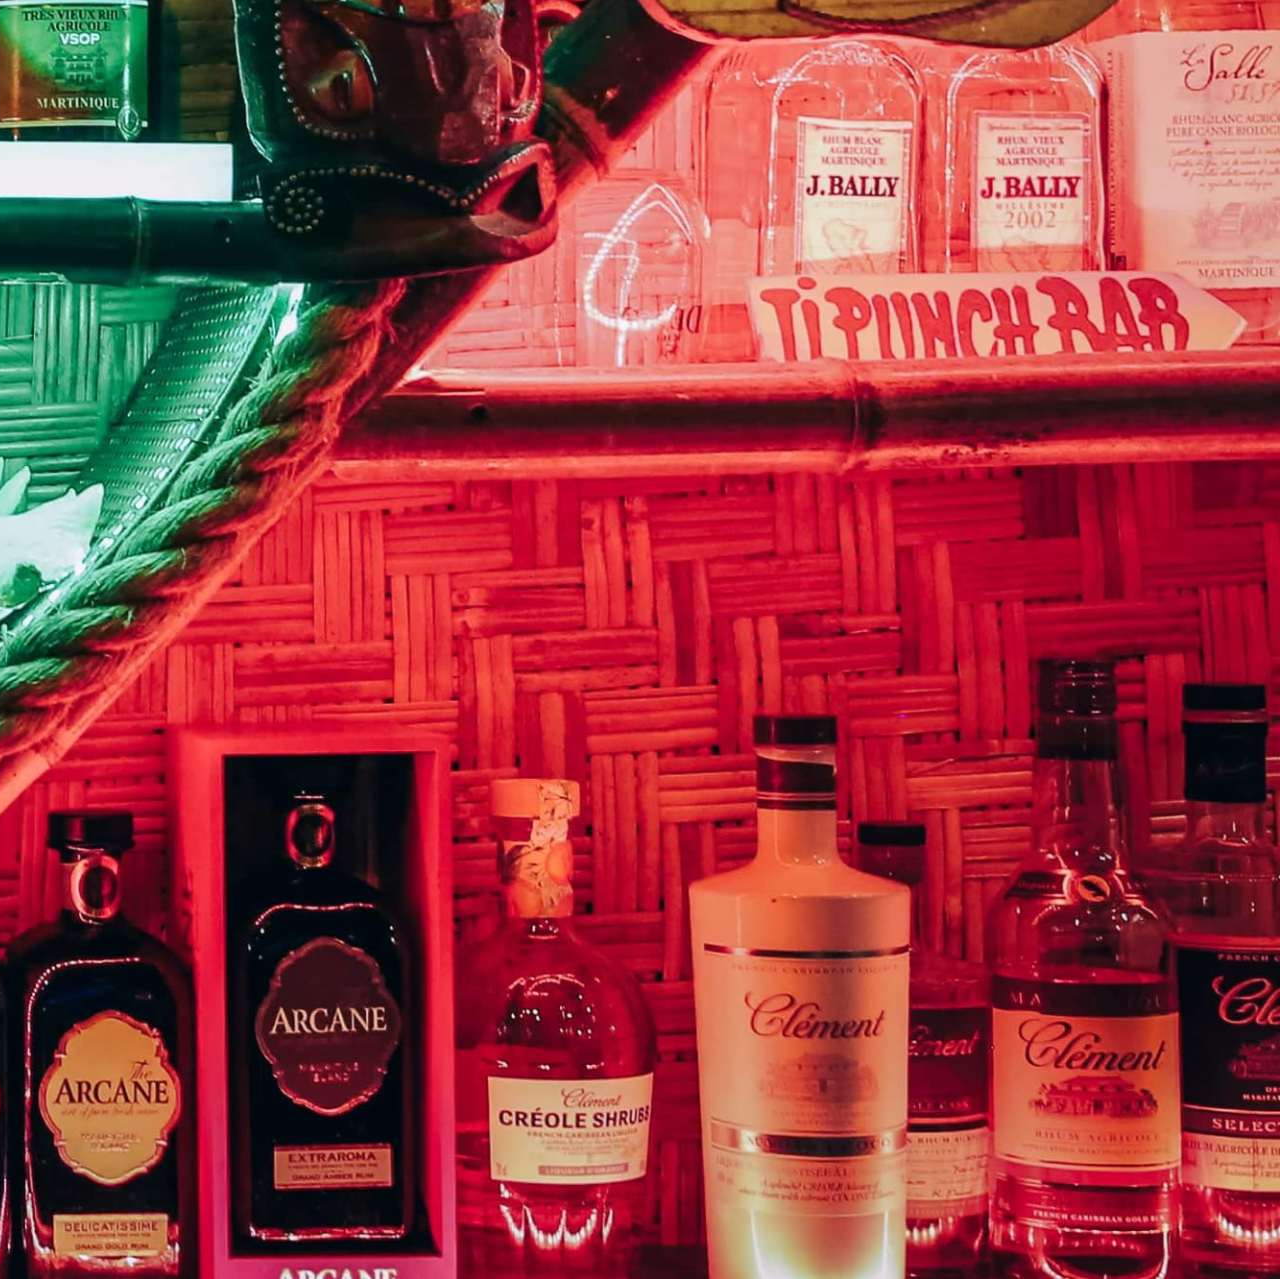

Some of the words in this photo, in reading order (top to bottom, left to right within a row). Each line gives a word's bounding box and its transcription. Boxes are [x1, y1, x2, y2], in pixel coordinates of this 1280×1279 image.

[57, 9, 98, 21] VIEUX
[46, 21, 112, 32] AGRICOLE
[59, 32, 101, 46] VSOP
[1184, 42, 1274, 92] Salle
[36, 96, 120, 109] MARTINIQUE
[997, 135, 1028, 145] RHUM
[1032, 135, 1066, 145] VIEUX
[1004, 146, 1058, 156] AGRICOLE
[820, 155, 887, 168] MARTINIQUE
[995, 157, 1066, 168] MARTINIQUE
[1003, 210, 1058, 229] 2002
[1197, 268, 1275, 279] MARTINIQUE
[269, 1006, 389, 1036] ARCANE
[743, 990, 886, 1040] Clément
[1018, 1018, 1167, 1072] Clément
[52, 1076, 170, 1105] ARCANE
[498, 1106, 587, 1129] CRÉOLE
[287, 1150, 378, 1164] EXTRAROMA
[63, 1221, 160, 1233] DELICATISSIME
